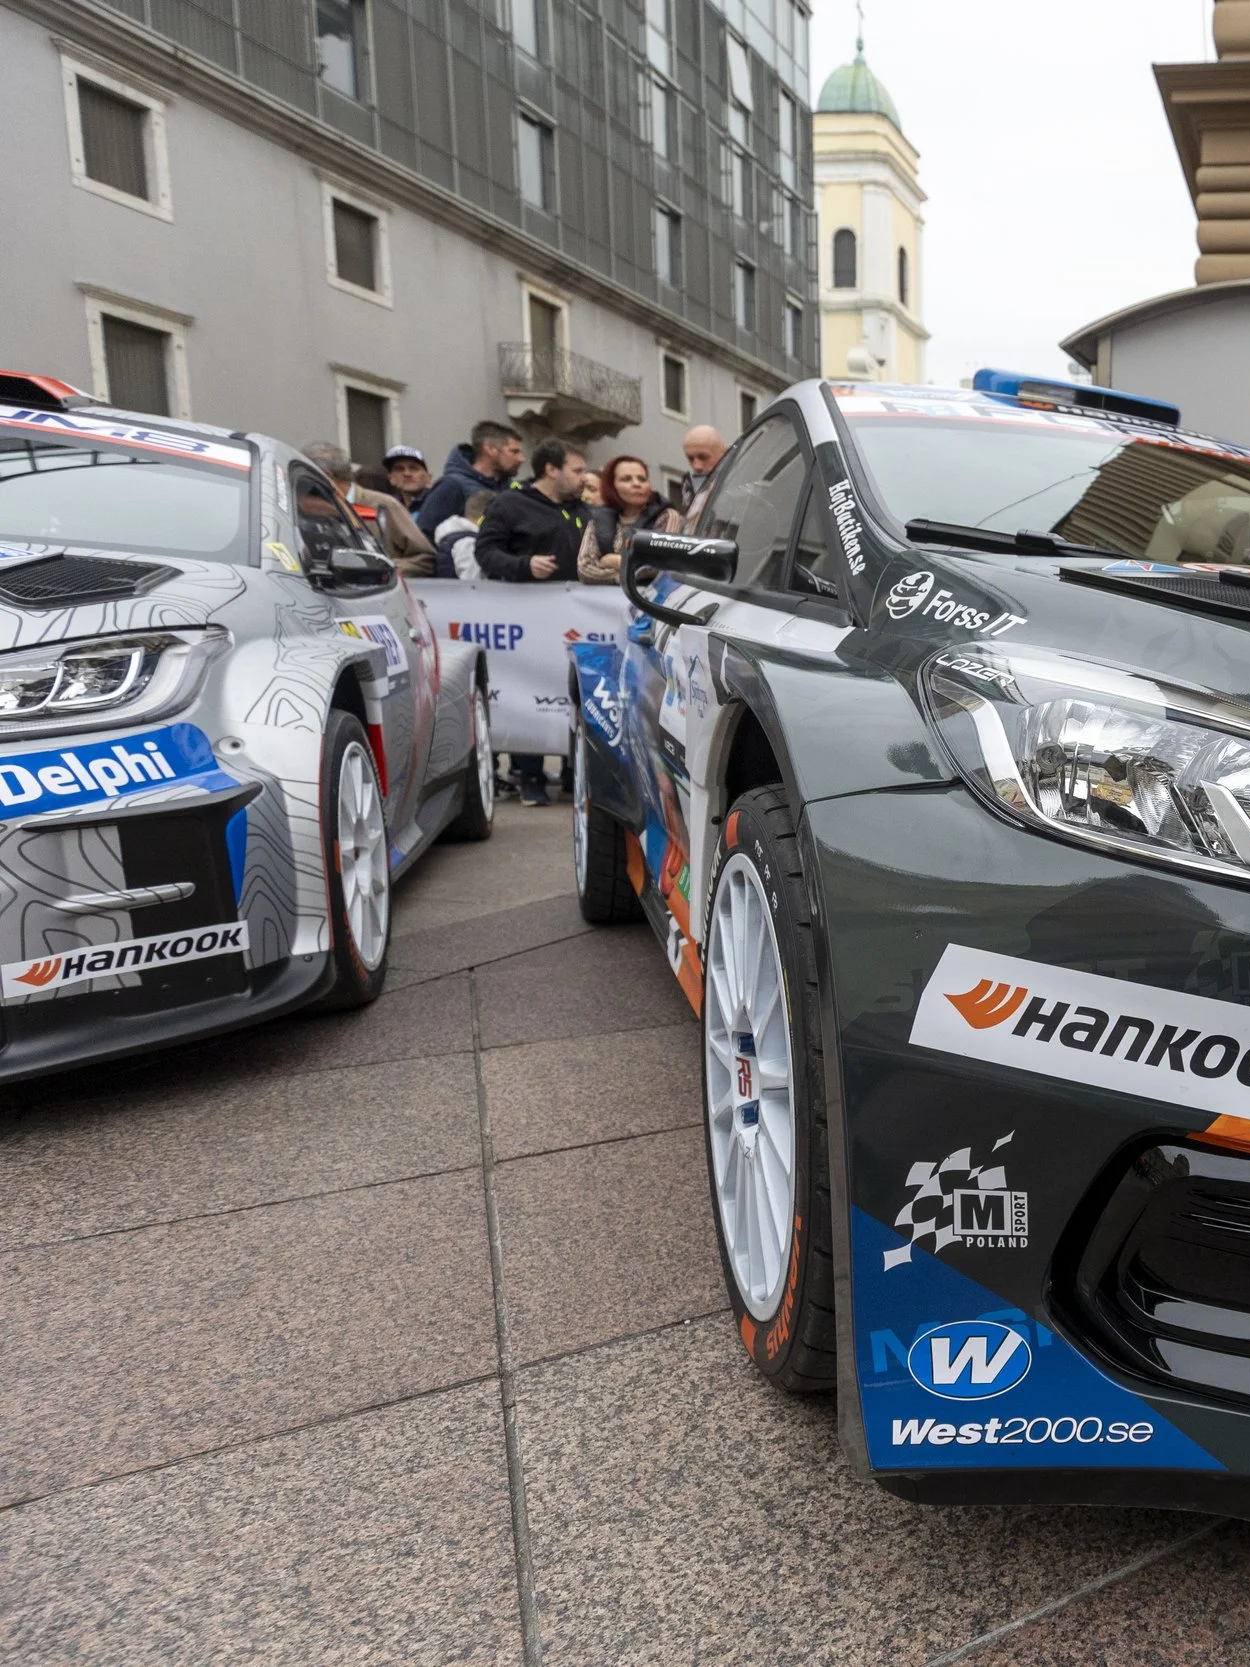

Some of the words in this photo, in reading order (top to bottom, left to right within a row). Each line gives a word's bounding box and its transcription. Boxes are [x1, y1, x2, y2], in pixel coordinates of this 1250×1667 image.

[922, 588, 990, 631] Forss
[979, 614, 1028, 637] IT
[468, 623, 524, 651] HEP
[0, 741, 176, 807] Delphi
[1013, 1194, 1027, 1234] SPORT
[966, 1236, 1028, 1249] POLAND
[930, 1330, 1028, 1386] W
[891, 1417, 1154, 1446] West2000.se
